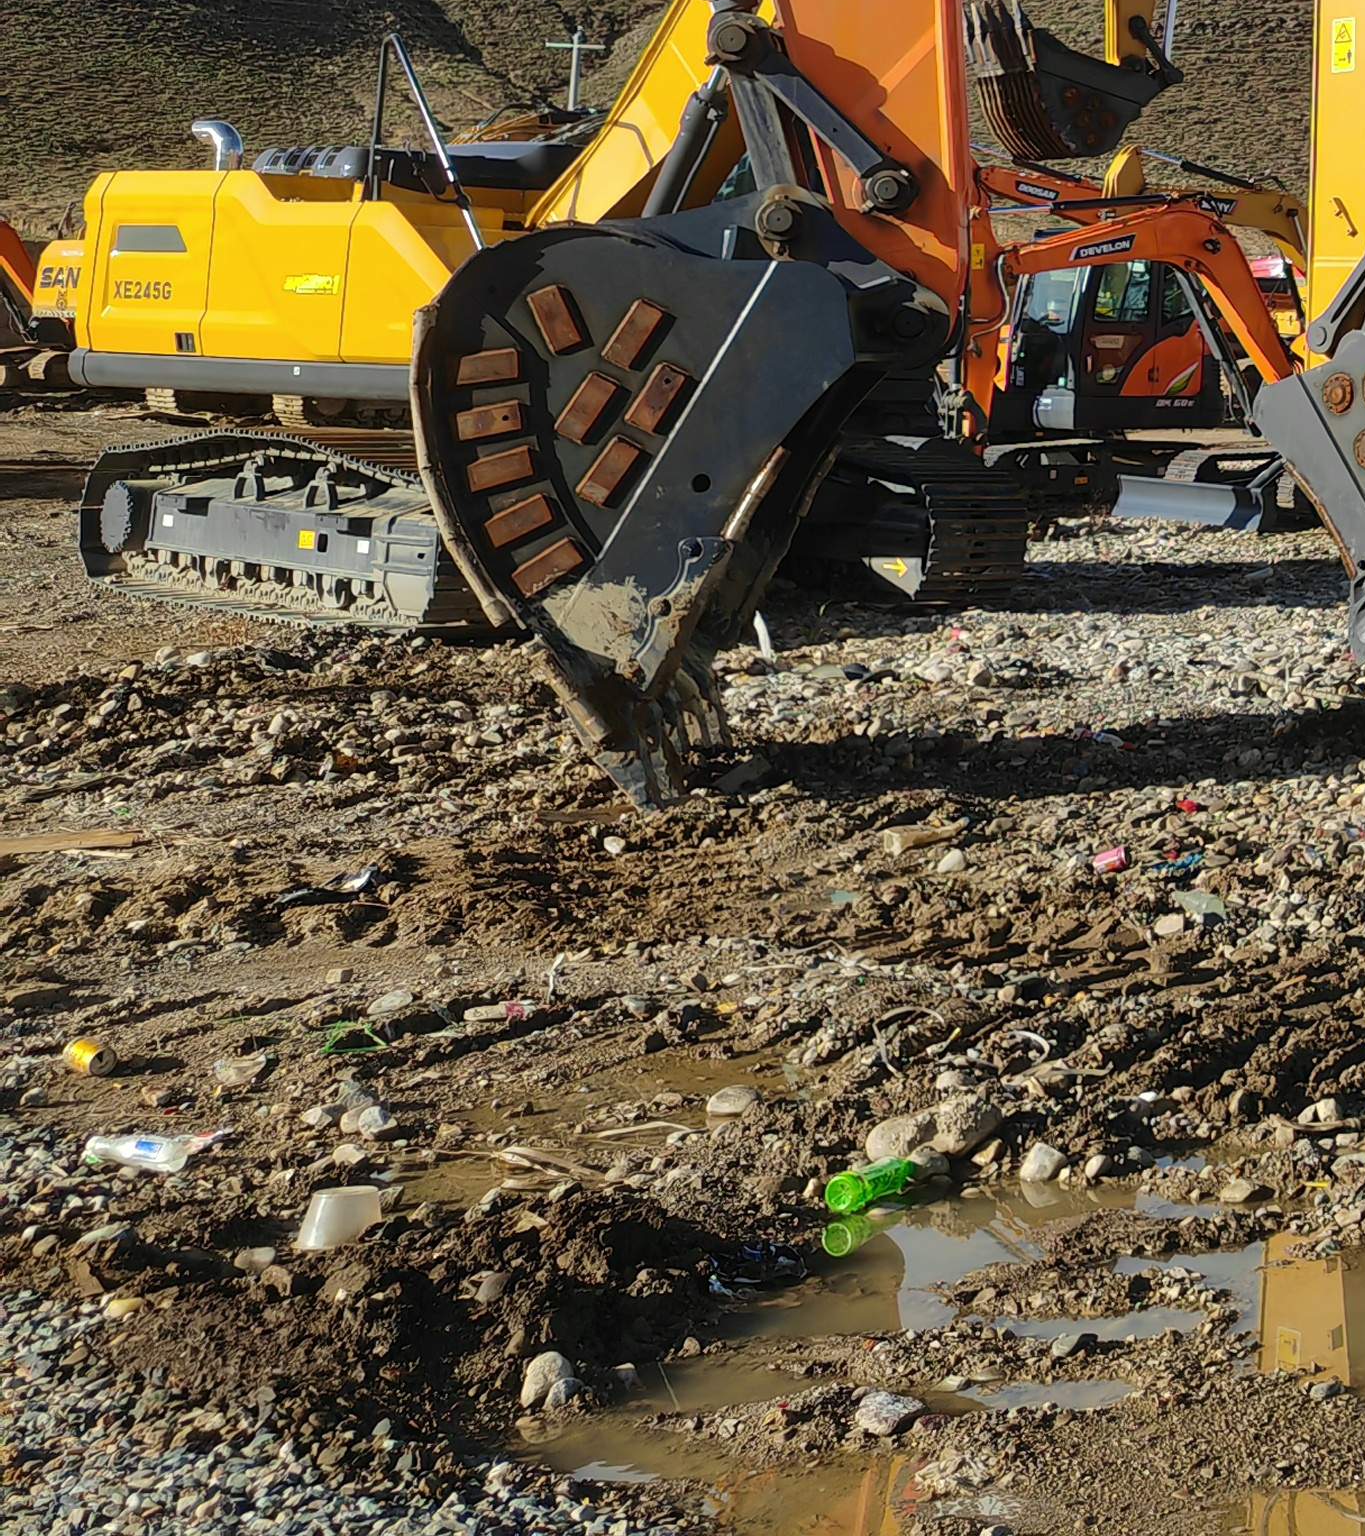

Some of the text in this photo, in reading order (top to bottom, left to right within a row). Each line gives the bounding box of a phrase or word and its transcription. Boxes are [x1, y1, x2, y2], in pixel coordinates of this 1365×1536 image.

[1017, 183, 1057, 200] DOOSAN
[1079, 239, 1131, 258] DEVELON
[39, 266, 82, 289] SAN
[113, 280, 173, 300] XE245G
